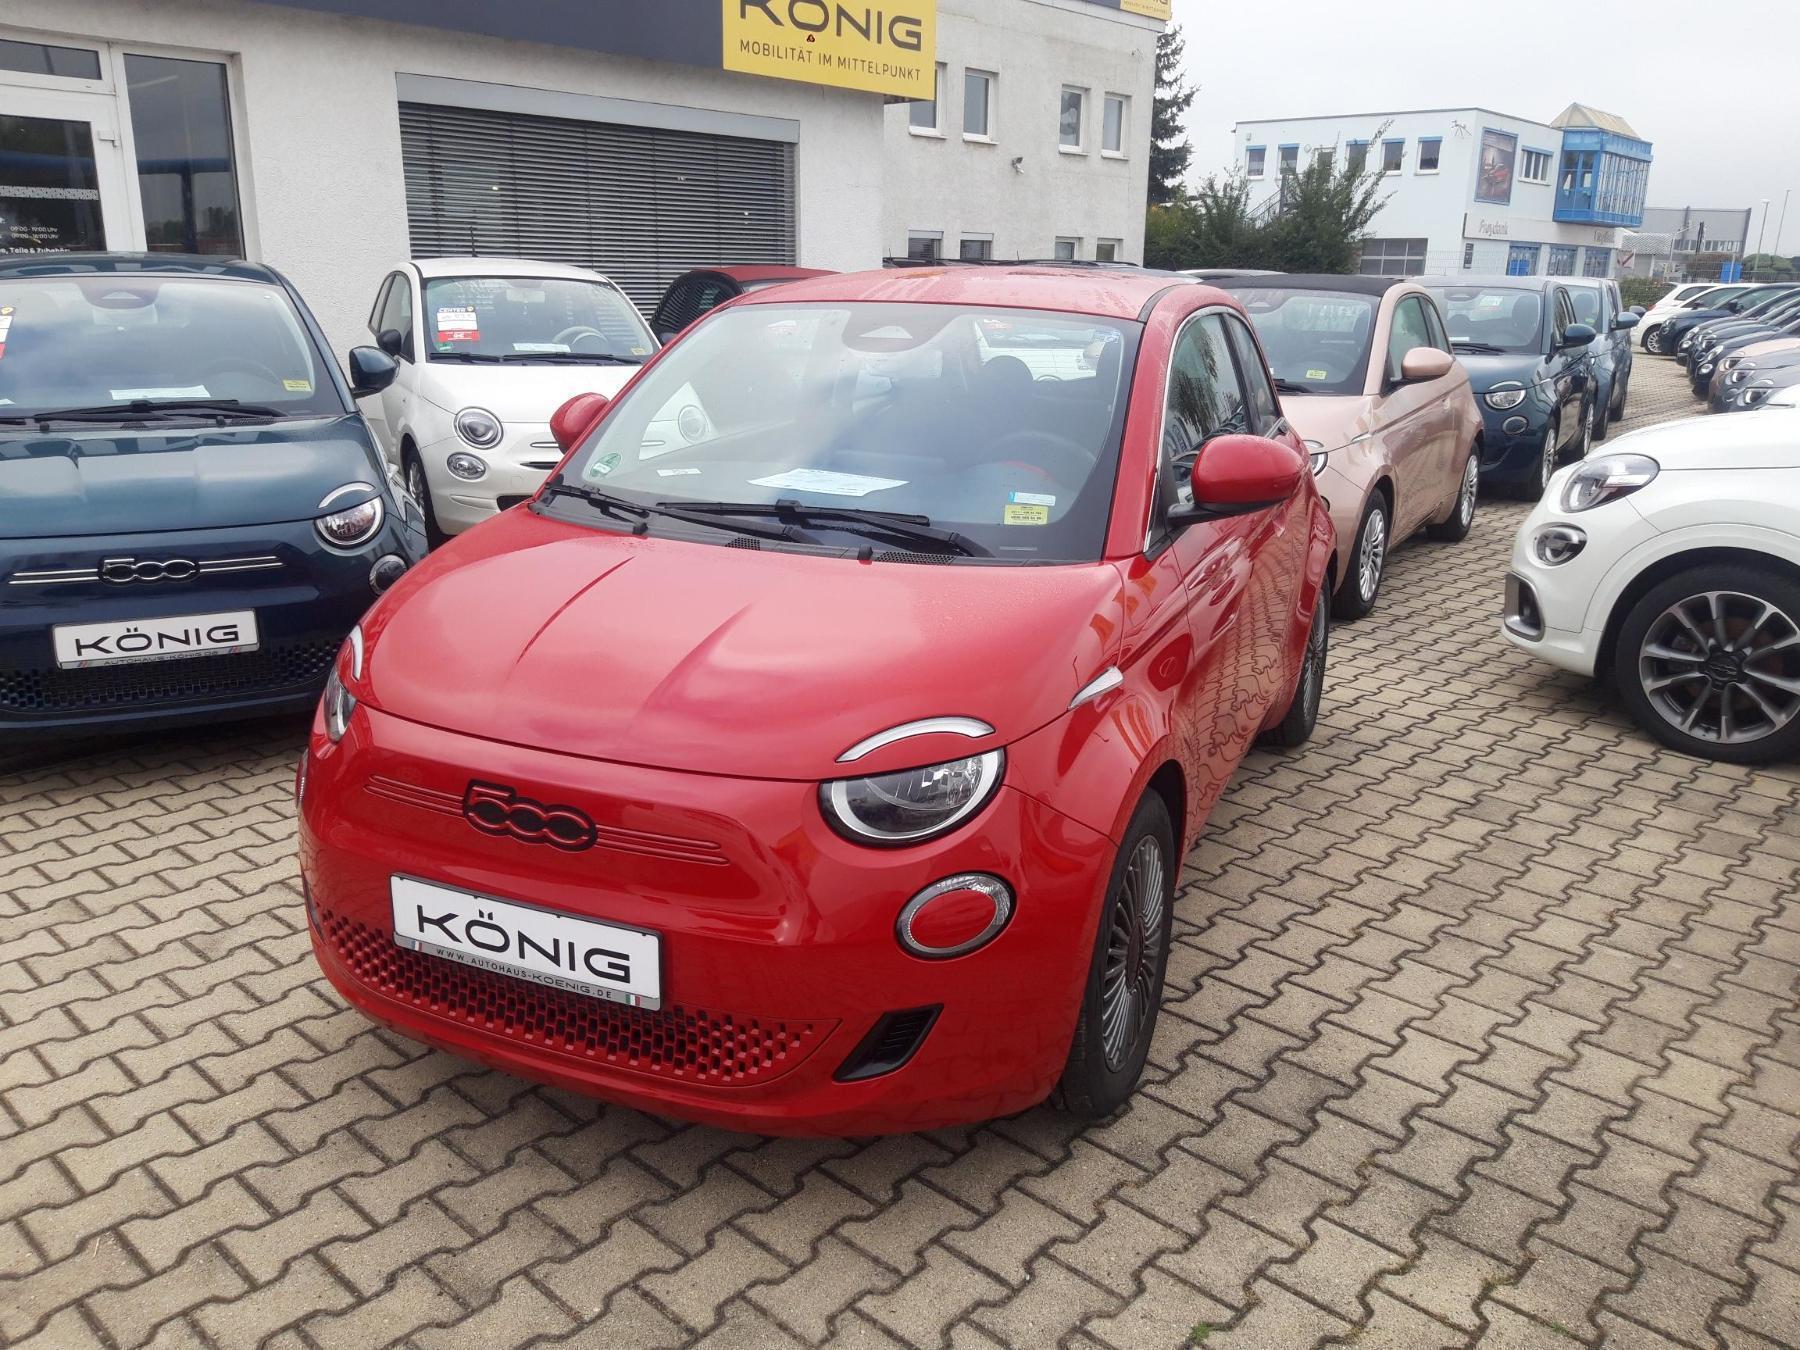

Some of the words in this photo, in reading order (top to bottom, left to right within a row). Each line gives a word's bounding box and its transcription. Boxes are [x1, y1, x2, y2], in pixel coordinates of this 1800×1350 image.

[740, 40, 813, 63] MOBILITÄT
[818, 52, 832, 67] IM
[837, 56, 921, 81] MITTELPUNKT
[103, 557, 197, 583] 500
[75, 623, 240, 657] KÖNIG
[465, 781, 597, 849] 500
[416, 904, 631, 984] KÖNIG
[436, 947, 613, 999] WWW.AUTOHAUS-KOENIG.DE
